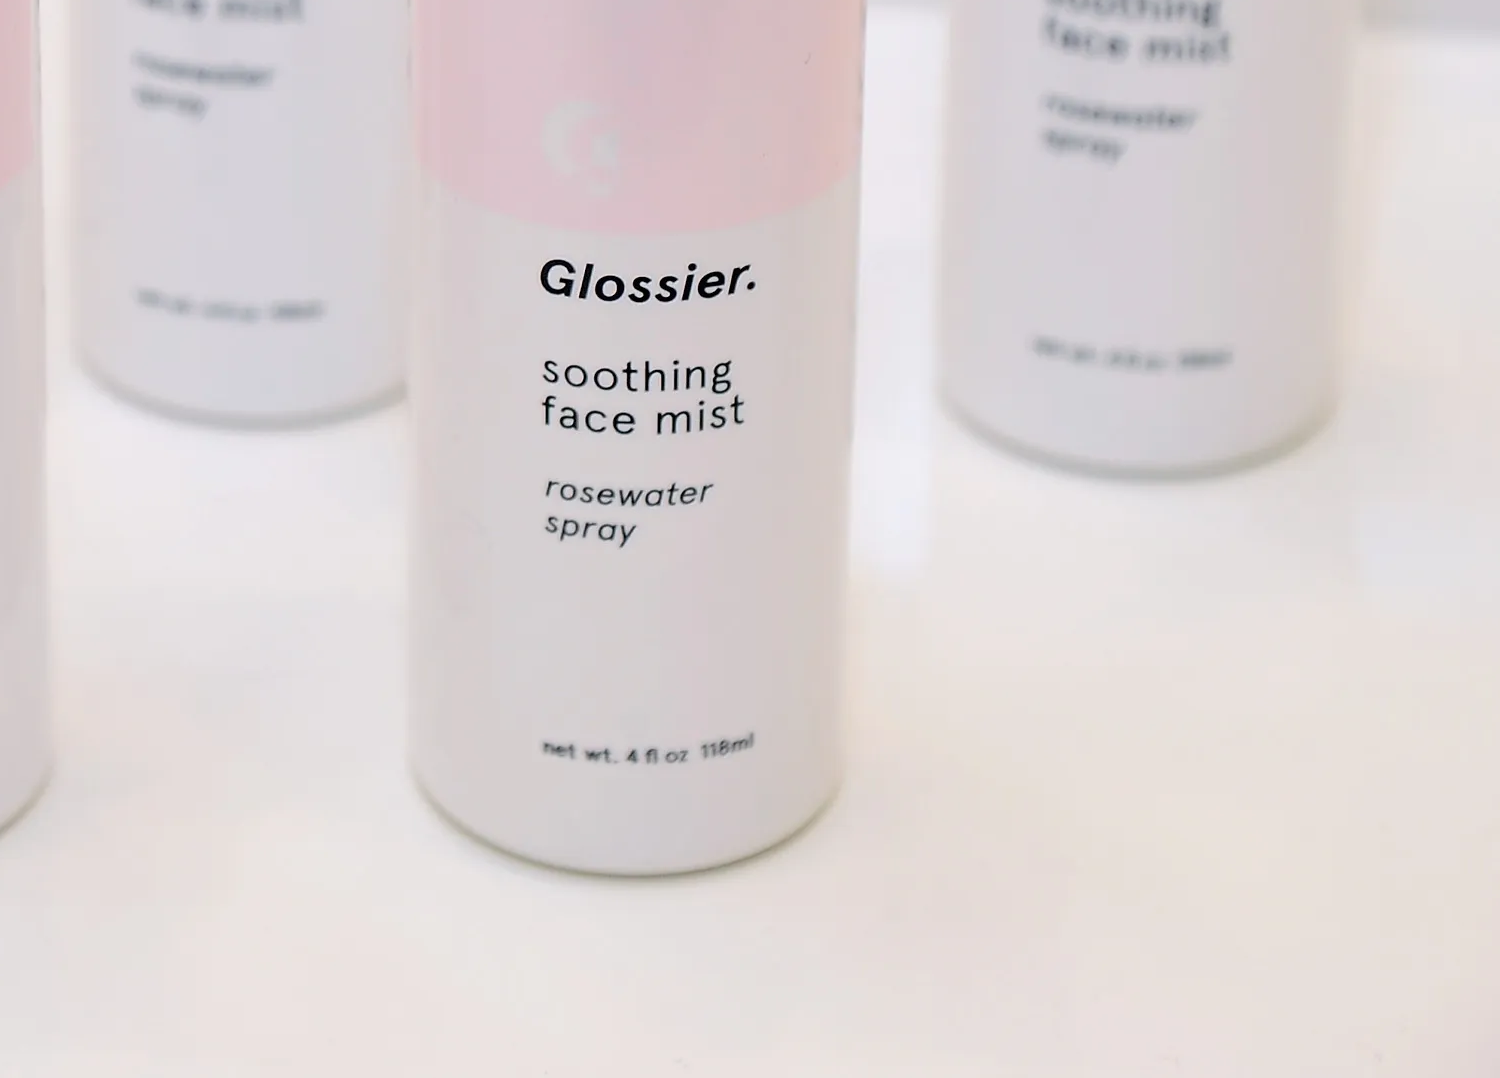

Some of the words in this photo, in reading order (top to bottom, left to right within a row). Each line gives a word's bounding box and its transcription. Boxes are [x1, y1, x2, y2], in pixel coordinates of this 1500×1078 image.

[539, 258, 757, 304] Glossier.
[541, 359, 734, 395] soothing
[541, 395, 637, 436] face
[655, 394, 746, 436] mist
[545, 479, 715, 508] rosewater
[544, 514, 637, 549] spray
[542, 740, 575, 759] net
[584, 748, 618, 764] wt.
[627, 748, 639, 764] 4
[645, 748, 658, 765] fl
[665, 750, 689, 765] oz
[700, 731, 756, 759] 118ml
